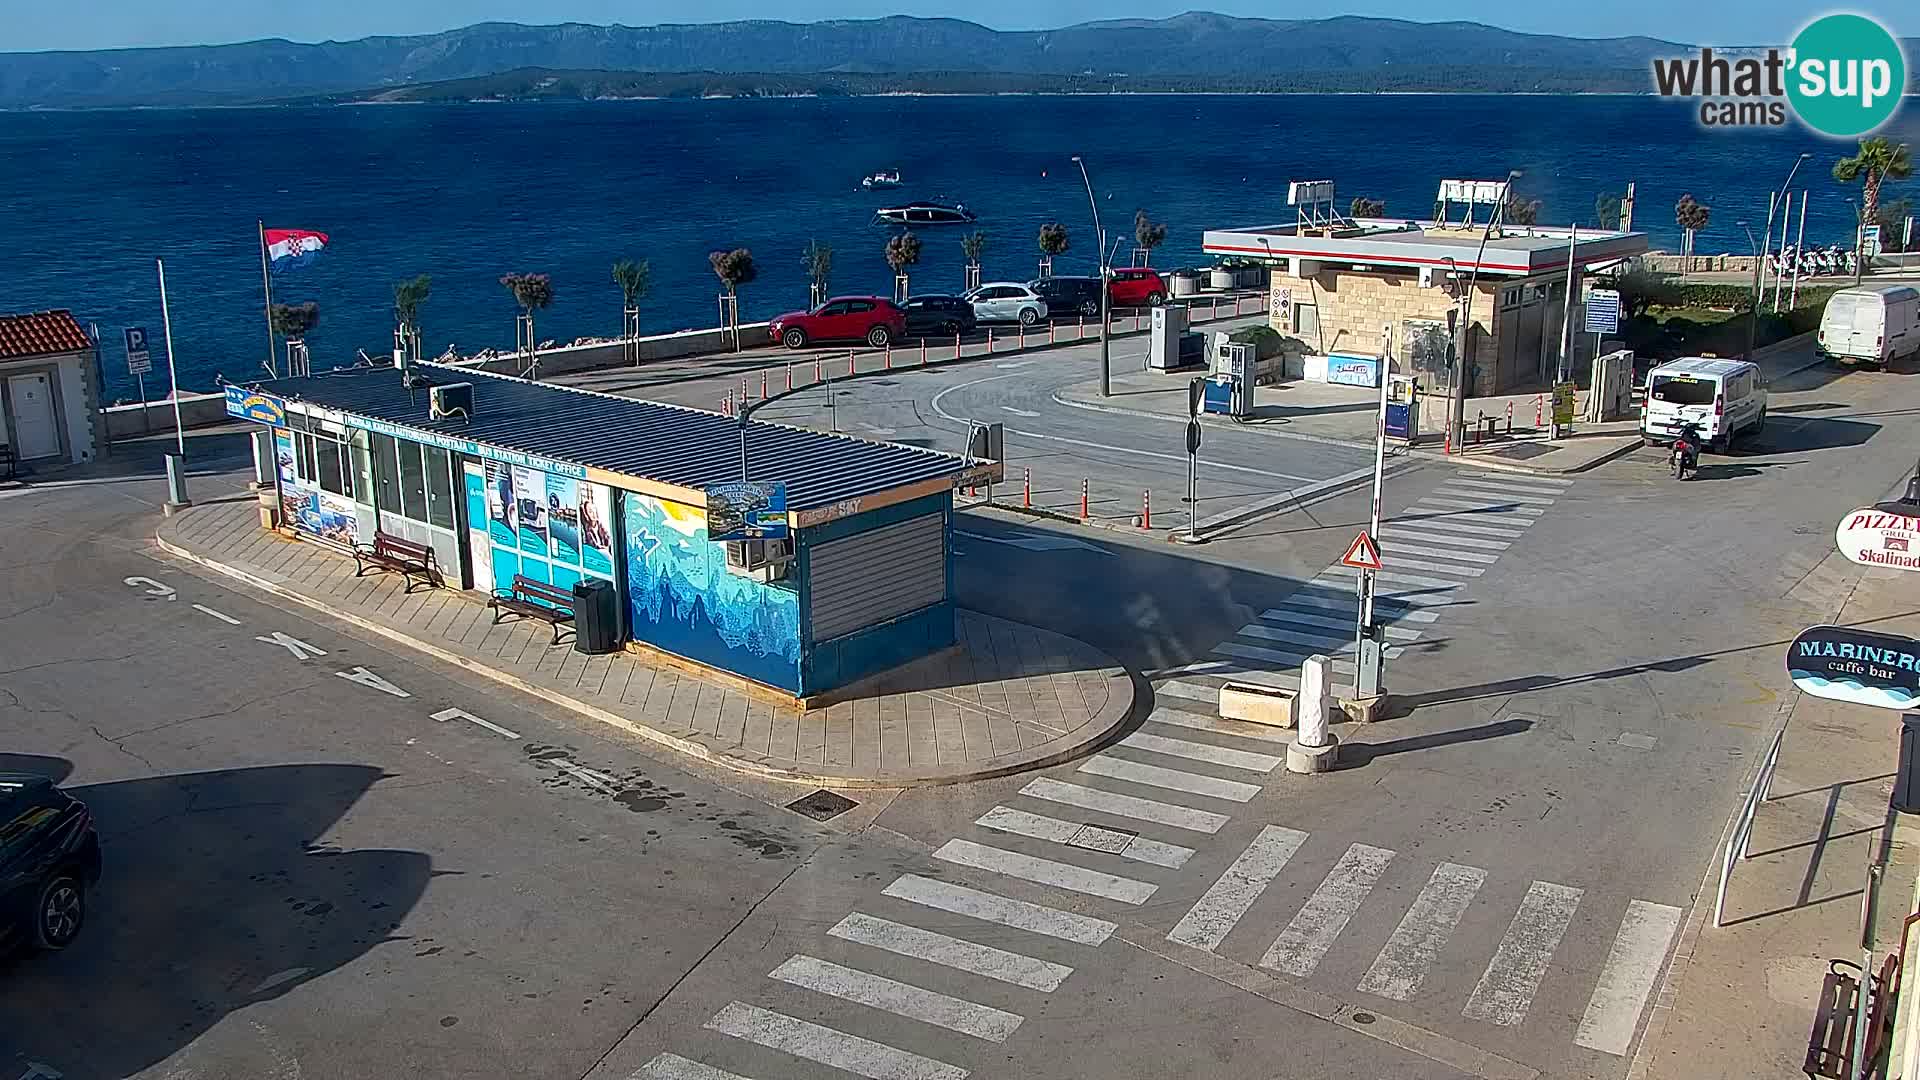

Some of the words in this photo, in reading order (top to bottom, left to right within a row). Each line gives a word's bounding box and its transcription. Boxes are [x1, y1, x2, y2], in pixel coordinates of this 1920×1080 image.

[130, 331, 142, 349] P
[436, 437, 467, 452] POSTAJA
[480, 446, 491, 458] BUS
[493, 450, 526, 464] STATION
[528, 457, 554, 471] TICKET
[555, 463, 582, 476] OFFICE
[1880, 529, 1917, 540] GRILL
[1828, 660, 1865, 675] caffe
[1869, 664, 1897, 680] bar
